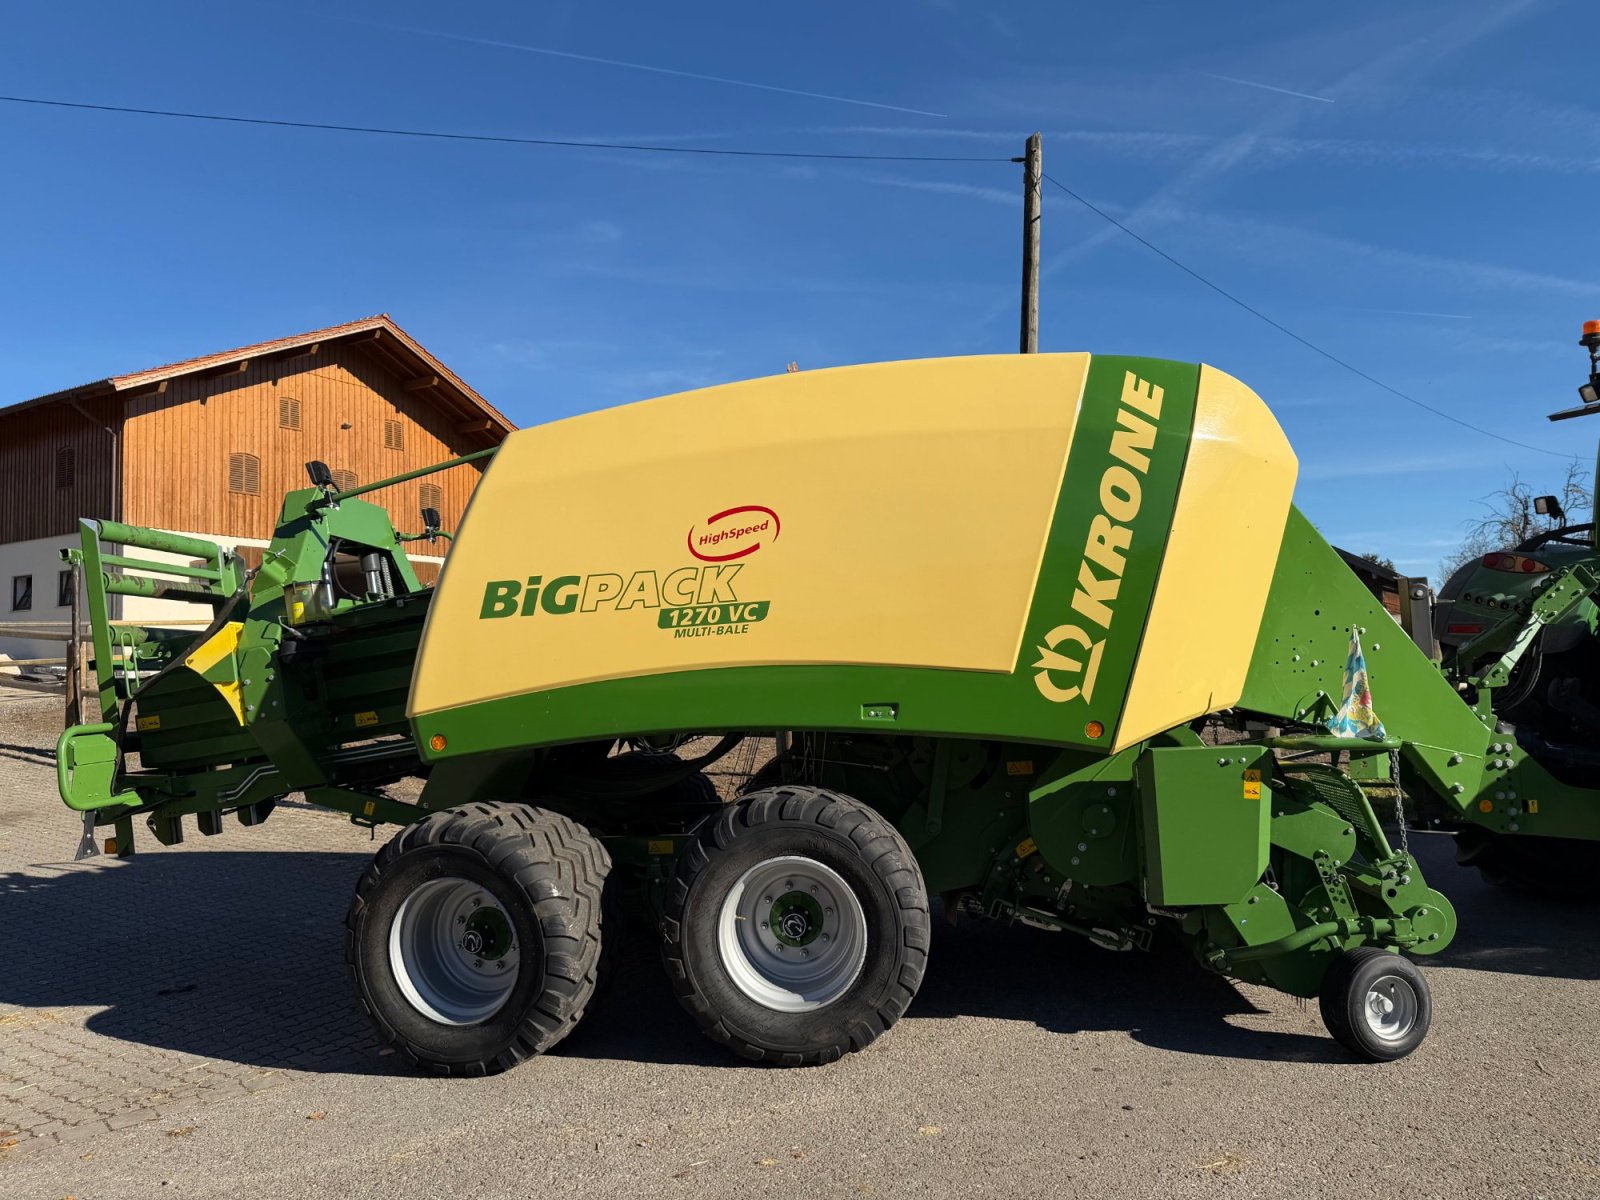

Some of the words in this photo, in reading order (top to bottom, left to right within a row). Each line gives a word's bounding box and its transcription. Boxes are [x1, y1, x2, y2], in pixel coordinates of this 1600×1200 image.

[1071, 370, 1165, 630] KRONE
[699, 519, 769, 546] HighSpeed
[669, 606, 721, 627] 1270
[729, 603, 759, 622] VC
[673, 623, 749, 639] MULTI-BALE
